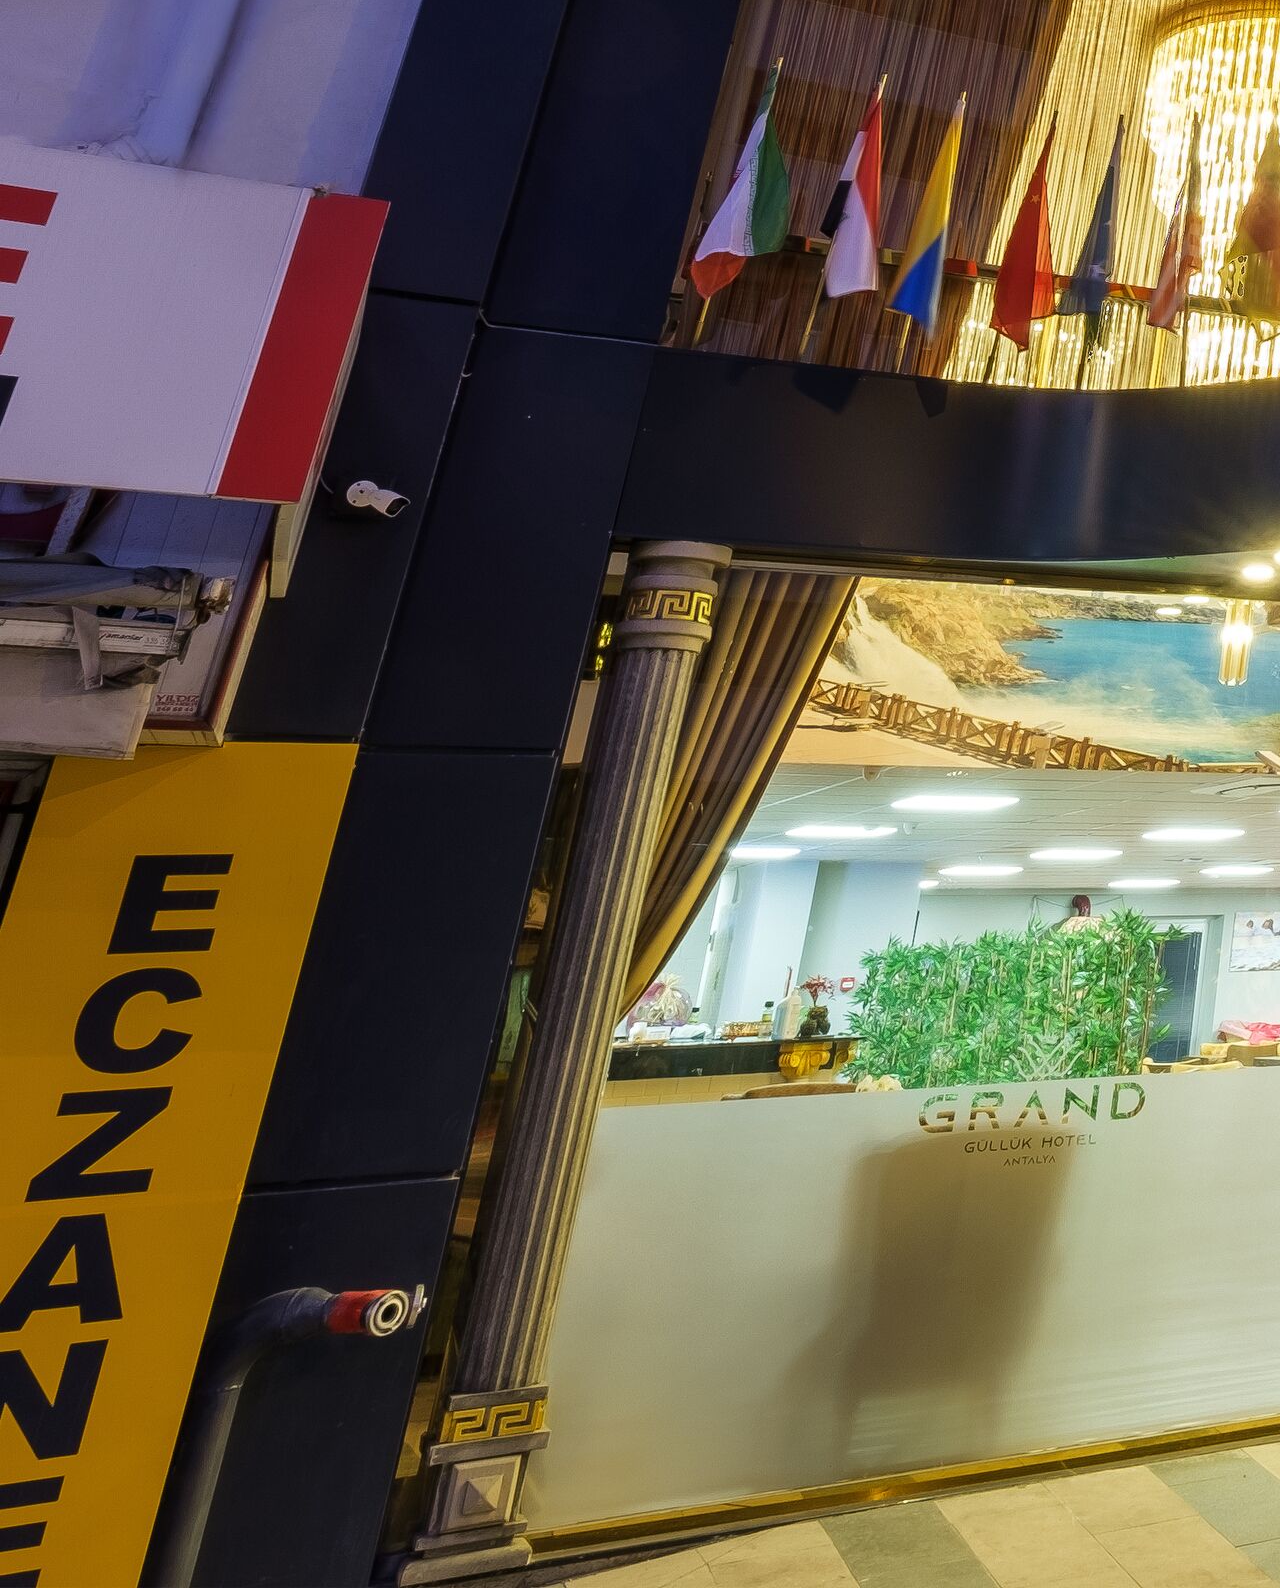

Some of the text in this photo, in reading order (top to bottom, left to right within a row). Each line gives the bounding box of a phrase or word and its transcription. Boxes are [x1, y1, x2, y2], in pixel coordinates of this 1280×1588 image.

[918, 1081, 1146, 1133] GRAND
[964, 1134, 1097, 1154] GÜLLÜK HOTEL
[1003, 1154, 1056, 1167] ANTALYA
